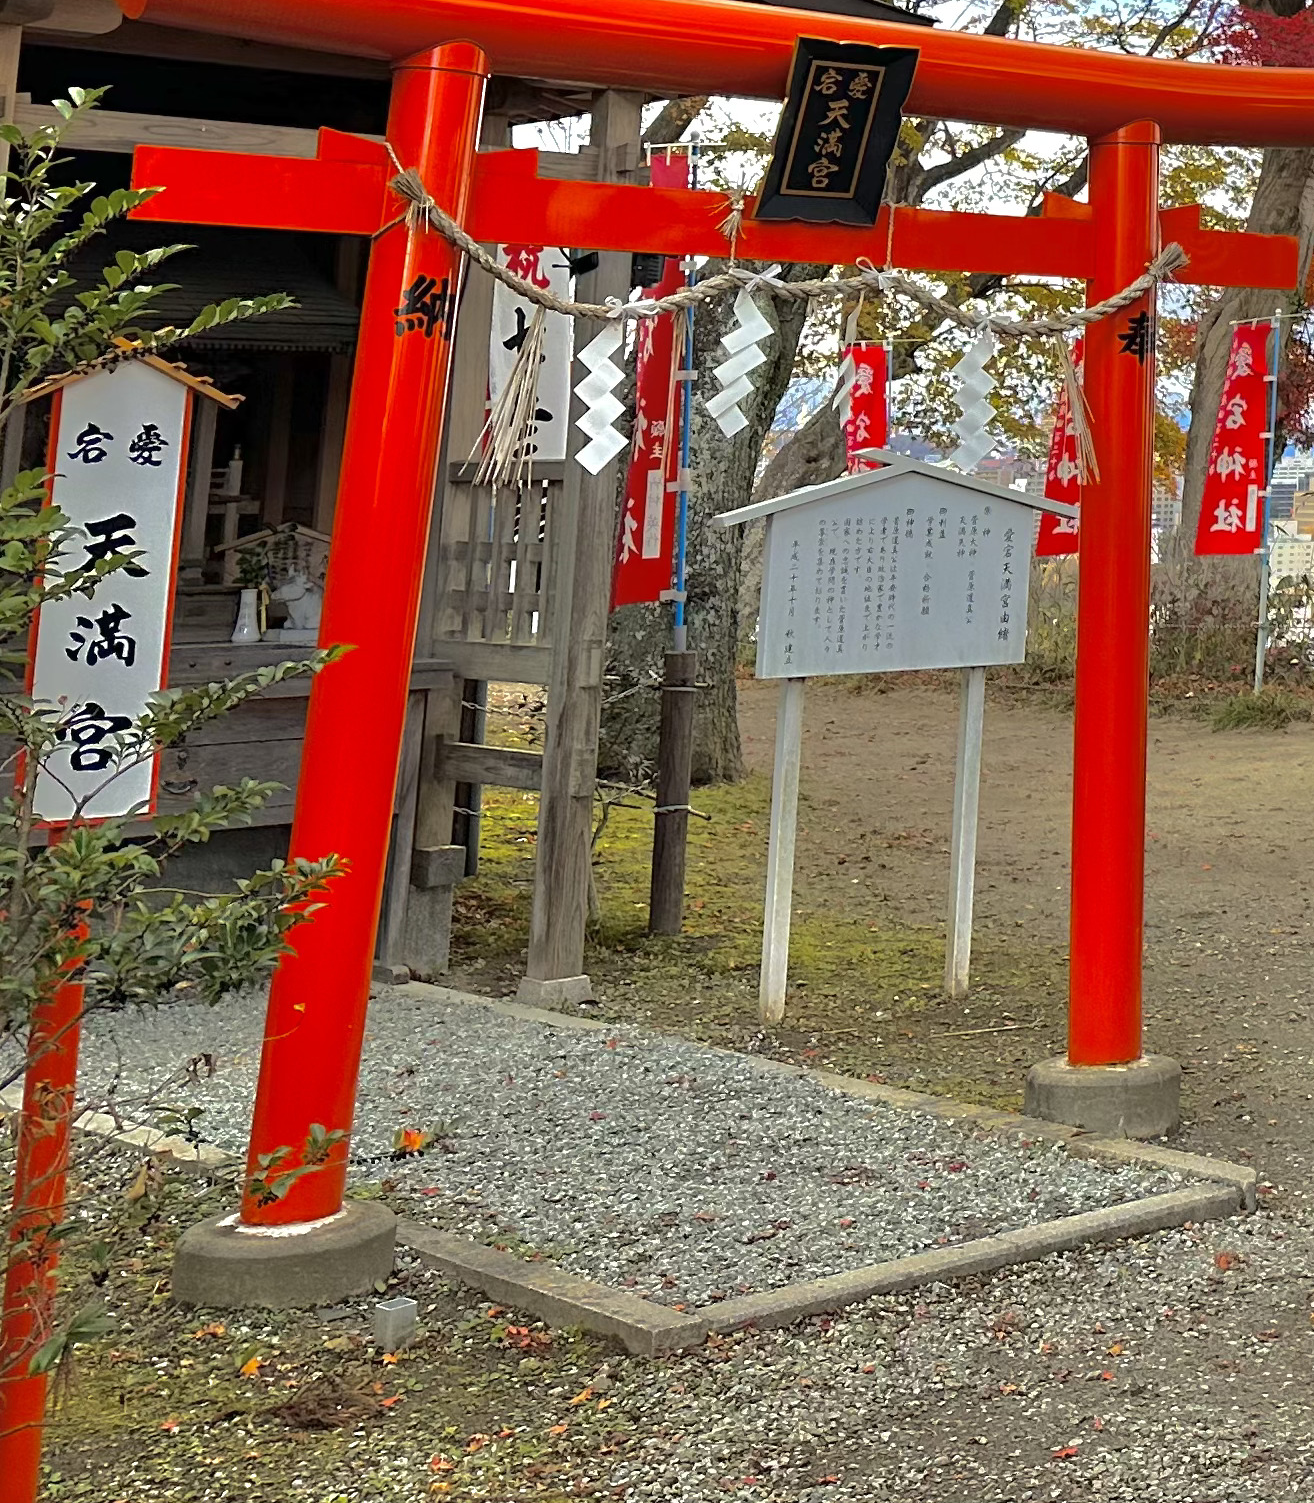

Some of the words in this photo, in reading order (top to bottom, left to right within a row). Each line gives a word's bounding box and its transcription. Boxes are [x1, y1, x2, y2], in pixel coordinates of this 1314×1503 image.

[814, 68, 872, 99] 愛宕
[807, 99, 851, 188] 天満宮
[393, 274, 456, 341] 納
[66, 422, 169, 467] 愛宕
[56, 513, 150, 772] 天満宮
